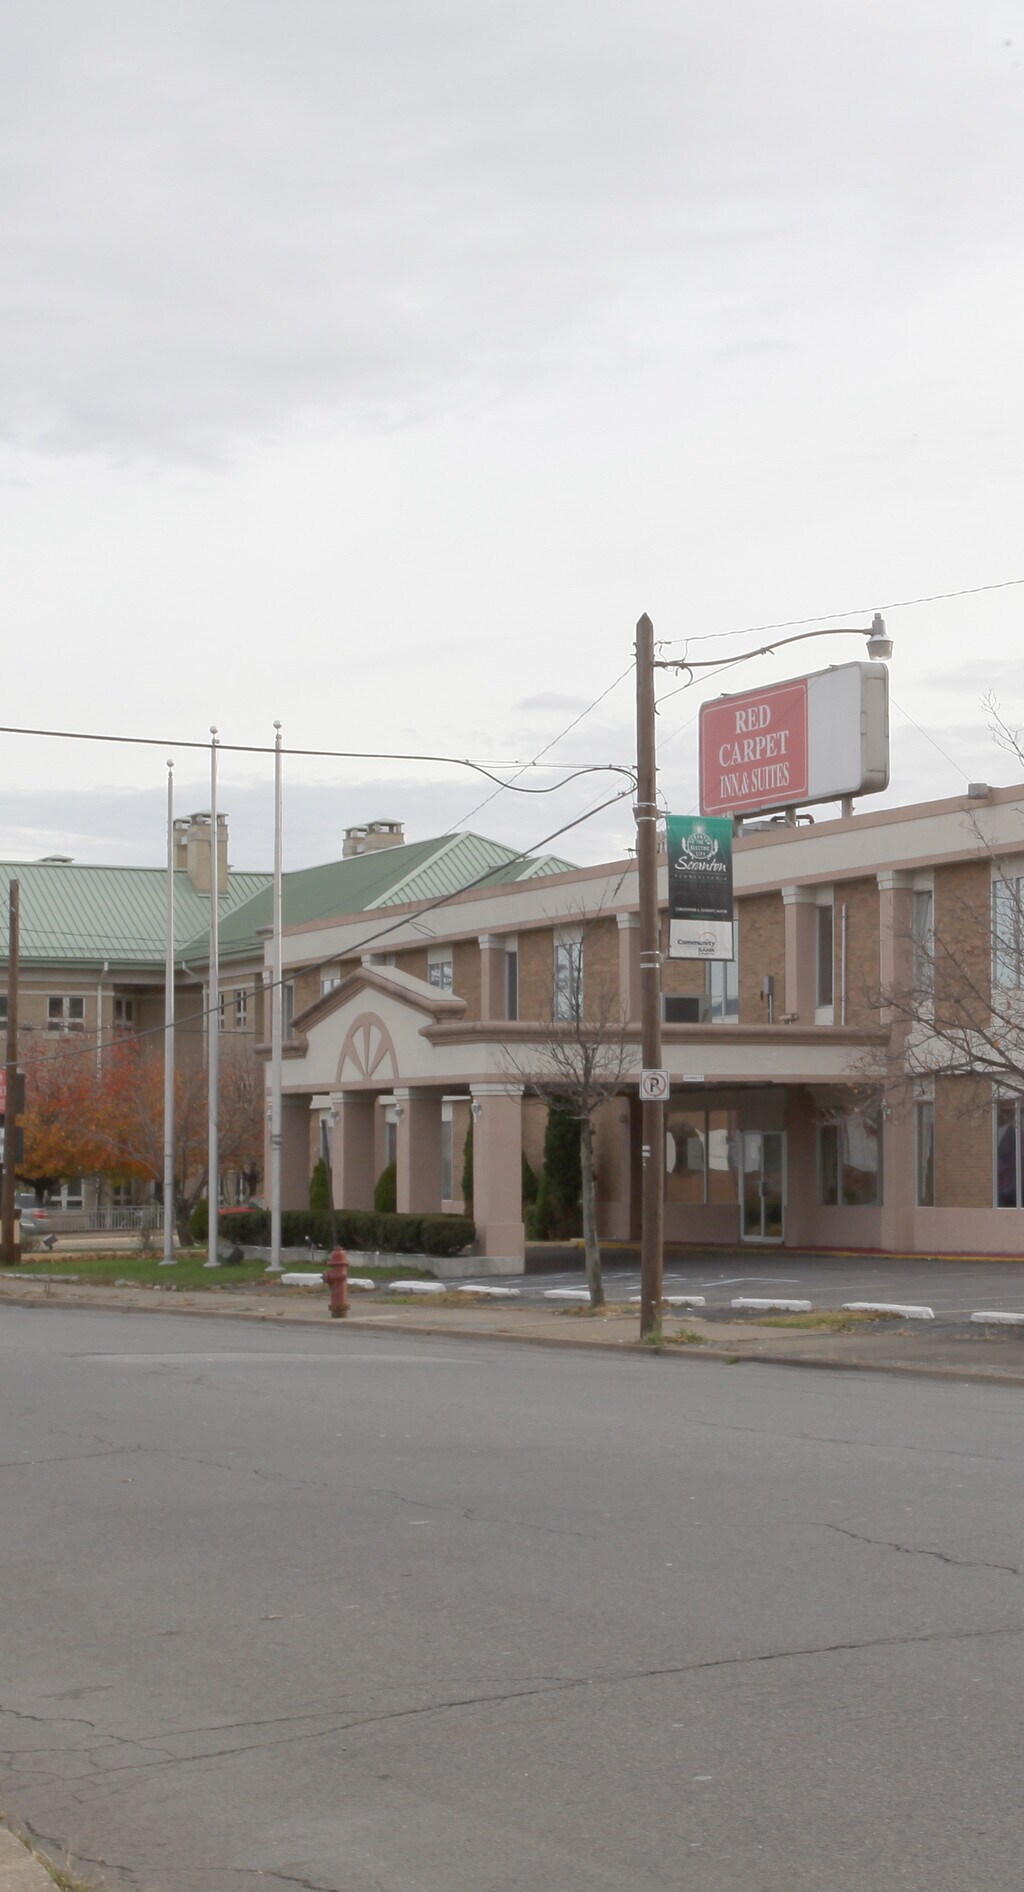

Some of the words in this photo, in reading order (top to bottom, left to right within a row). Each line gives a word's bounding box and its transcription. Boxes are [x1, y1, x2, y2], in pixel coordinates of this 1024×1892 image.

[735, 704, 771, 734] RED
[719, 730, 789, 767] CARPET
[751, 762, 790, 793] SUITES
[674, 855, 727, 872] Scranton
[677, 938, 715, 947] Community
